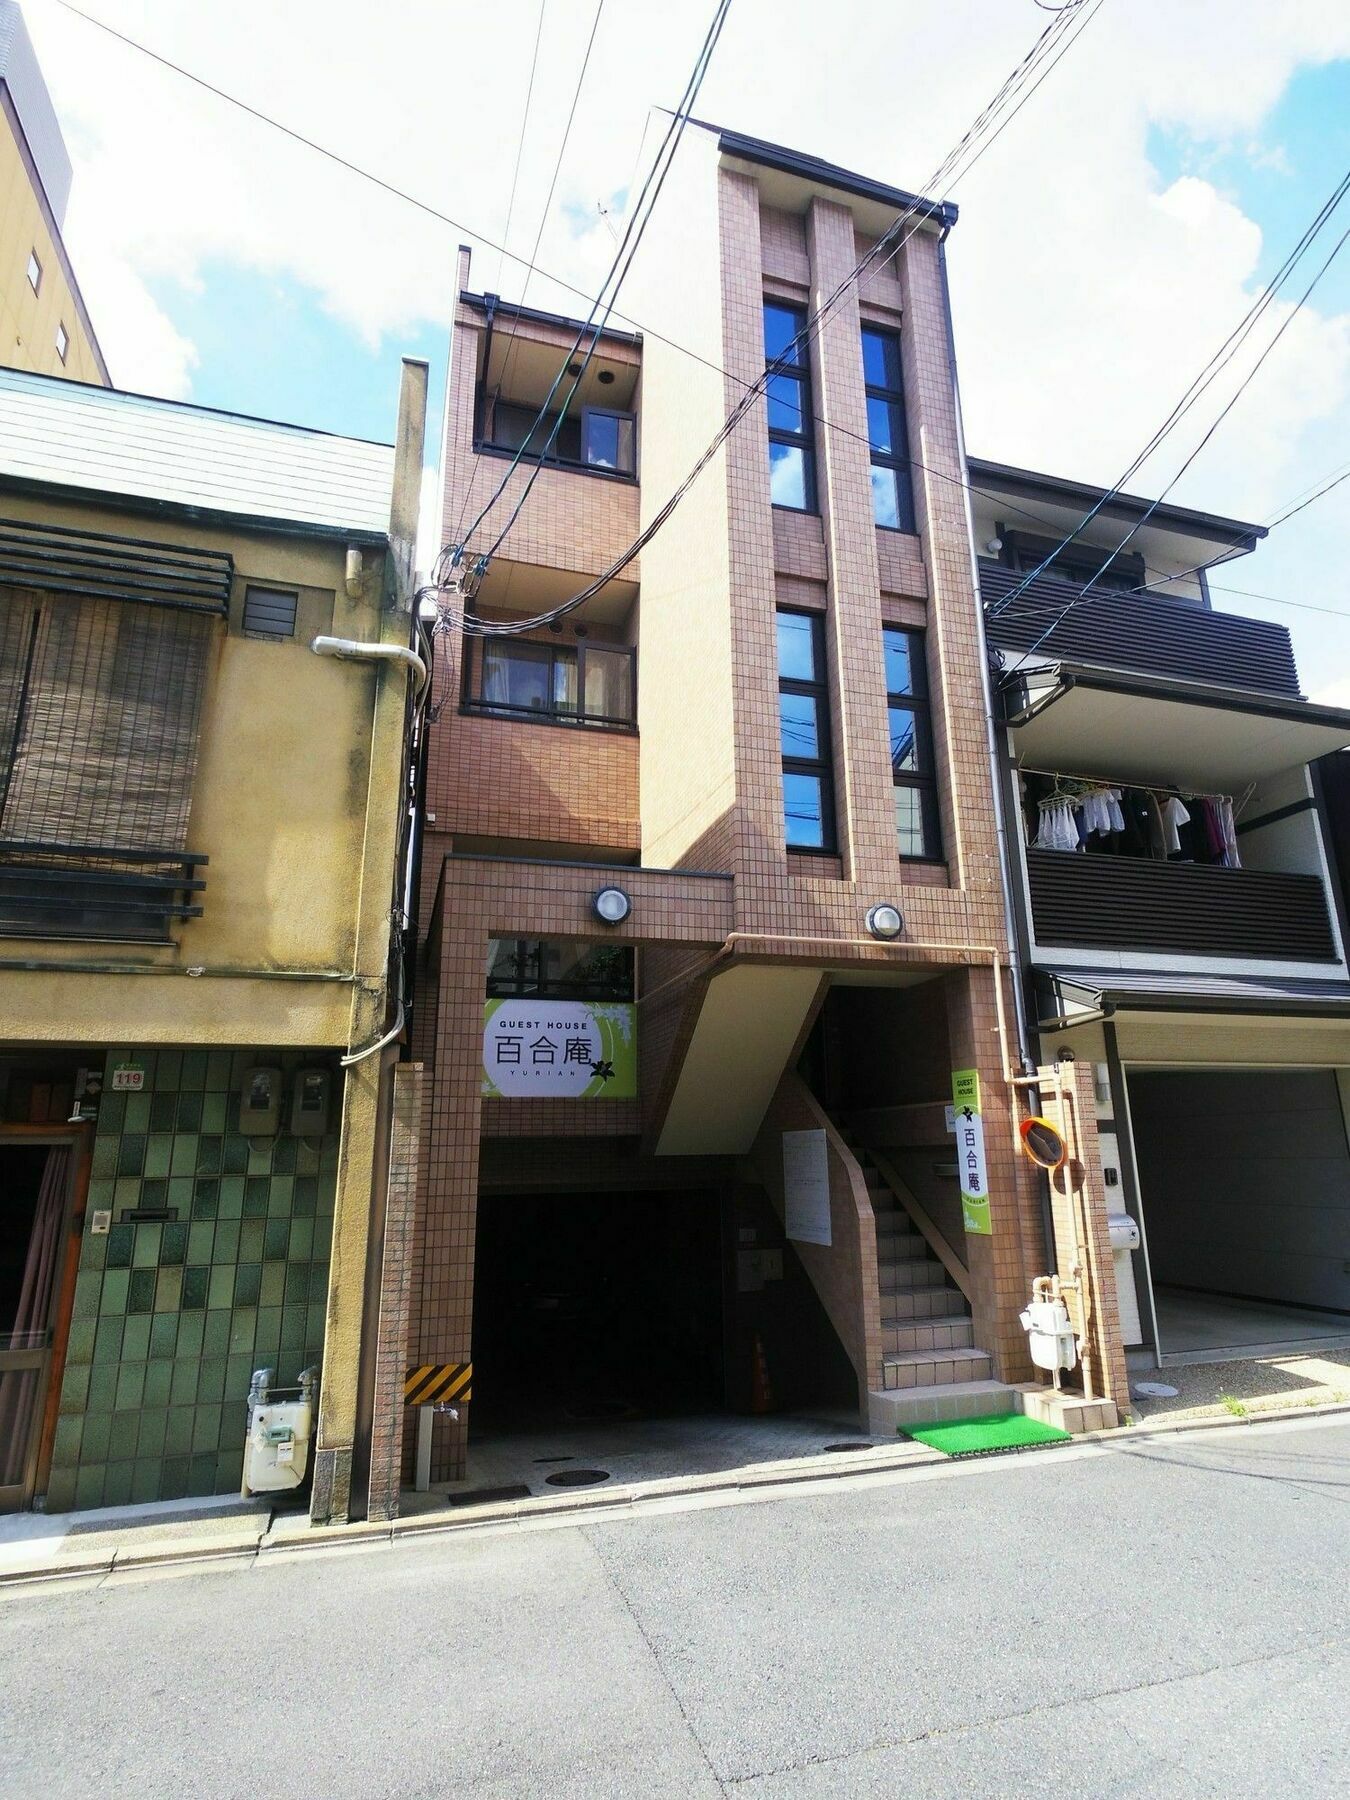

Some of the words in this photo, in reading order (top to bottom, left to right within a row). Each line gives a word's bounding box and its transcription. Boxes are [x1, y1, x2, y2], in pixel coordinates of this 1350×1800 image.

[499, 1021, 540, 1029] GUEST
[547, 1022, 587, 1030] HOUSE
[495, 1036, 592, 1065] 百合庵
[117, 1074, 140, 1083] 119
[965, 1129, 980, 1191] 百合庵
